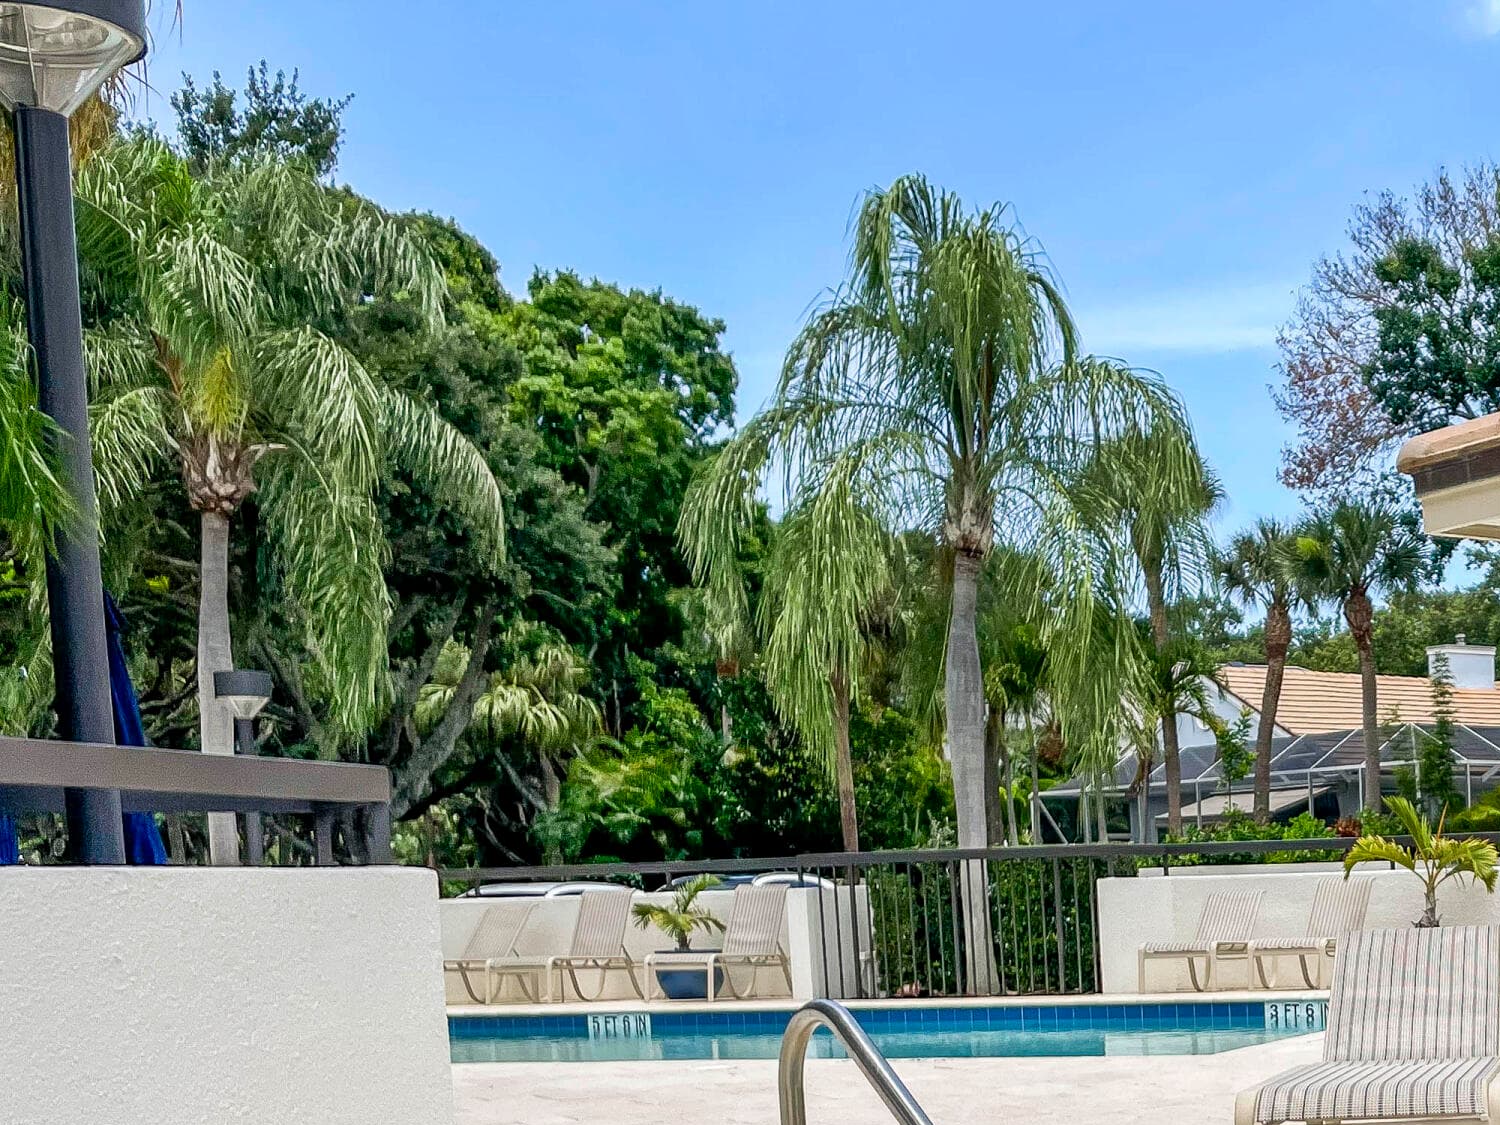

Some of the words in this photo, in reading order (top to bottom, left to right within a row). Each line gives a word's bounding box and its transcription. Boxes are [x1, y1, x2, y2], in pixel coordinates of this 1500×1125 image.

[1270, 1003, 1279, 1022] 3
[1305, 1003, 1315, 1022] 6
[592, 1015, 600, 1034] 5
[604, 1015, 618, 1034] FT
[622, 1015, 631, 1034] 6
[635, 1014, 647, 1034] IN
